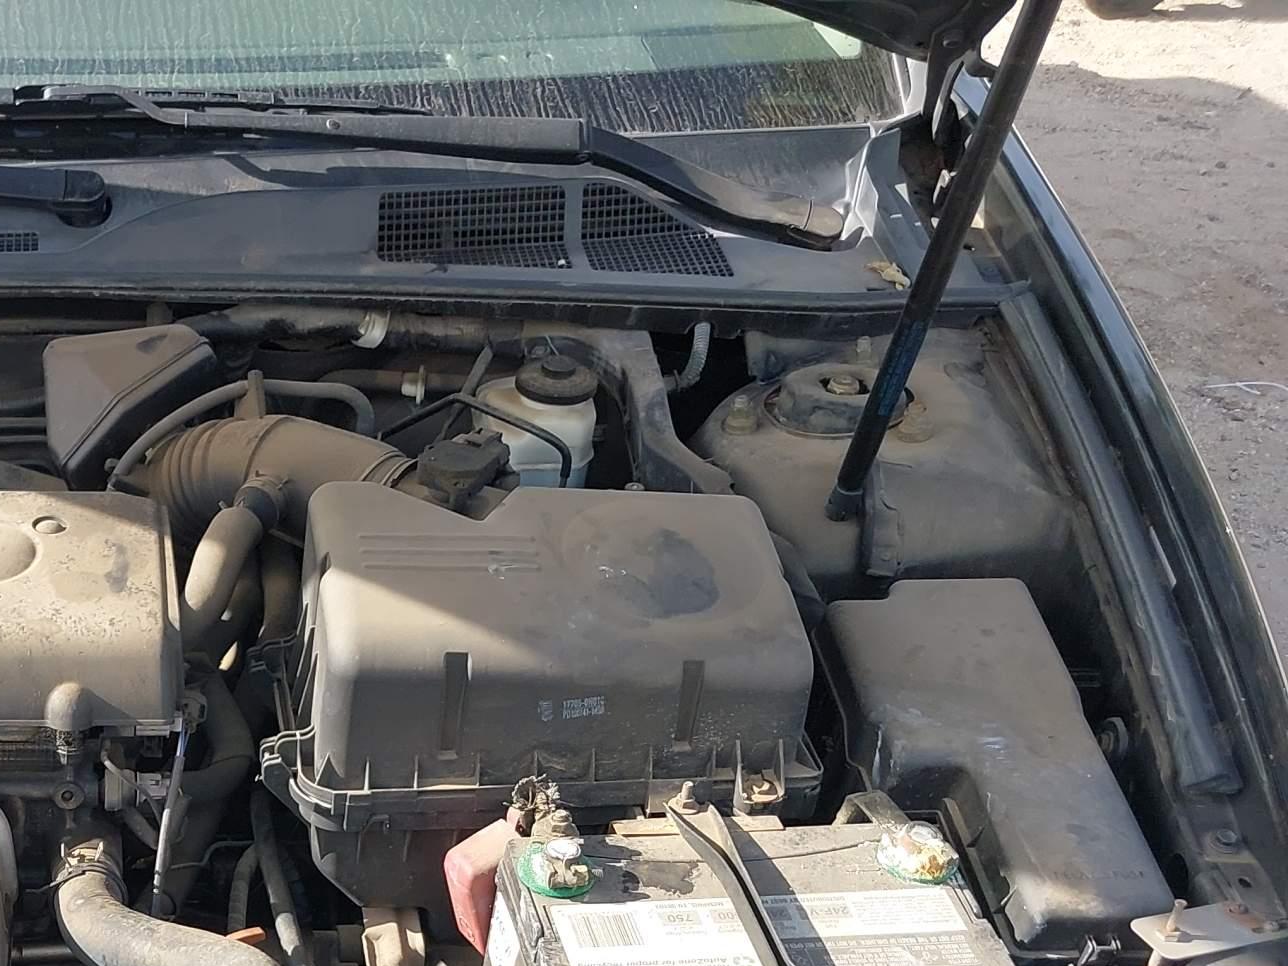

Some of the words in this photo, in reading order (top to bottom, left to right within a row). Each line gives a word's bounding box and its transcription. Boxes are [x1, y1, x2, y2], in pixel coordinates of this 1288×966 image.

[666, 913, 695, 923] 750
[626, 958, 659, 966] proper
[678, 957, 728, 966] AutoZone
